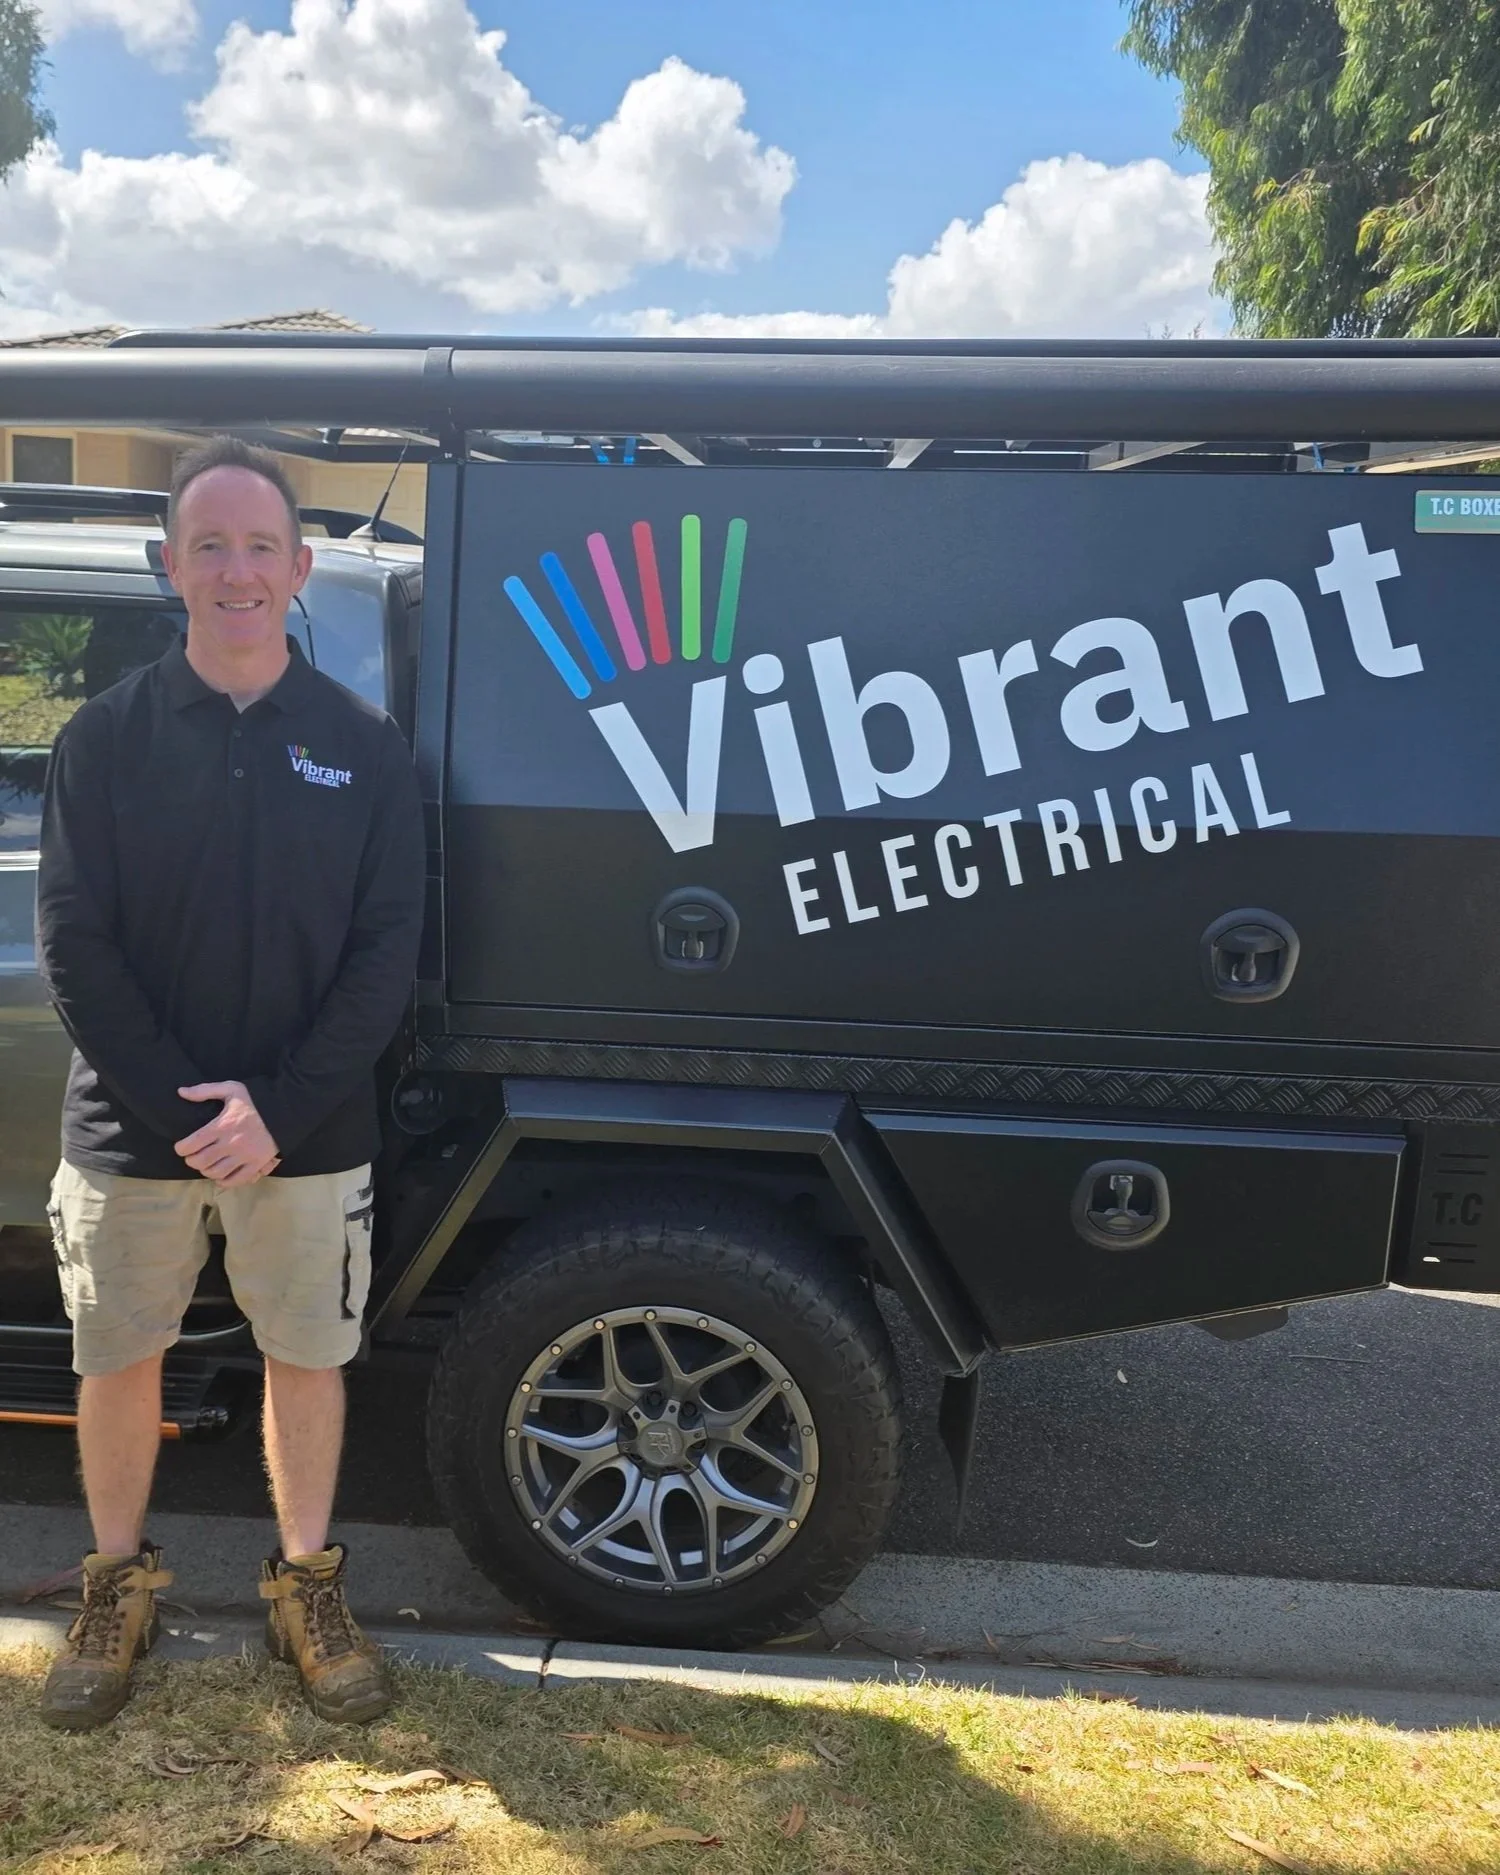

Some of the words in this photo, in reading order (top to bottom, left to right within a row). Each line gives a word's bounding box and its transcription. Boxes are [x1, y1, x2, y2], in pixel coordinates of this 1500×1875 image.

[1430, 497, 1455, 516] T.C
[588, 522, 1424, 854] Vibrant
[291, 756, 352, 784] Vibrant
[304, 773, 341, 788] ELECTRICAL
[782, 752, 1292, 935] ELECTRICAL
[1432, 1192, 1484, 1227] T.C
